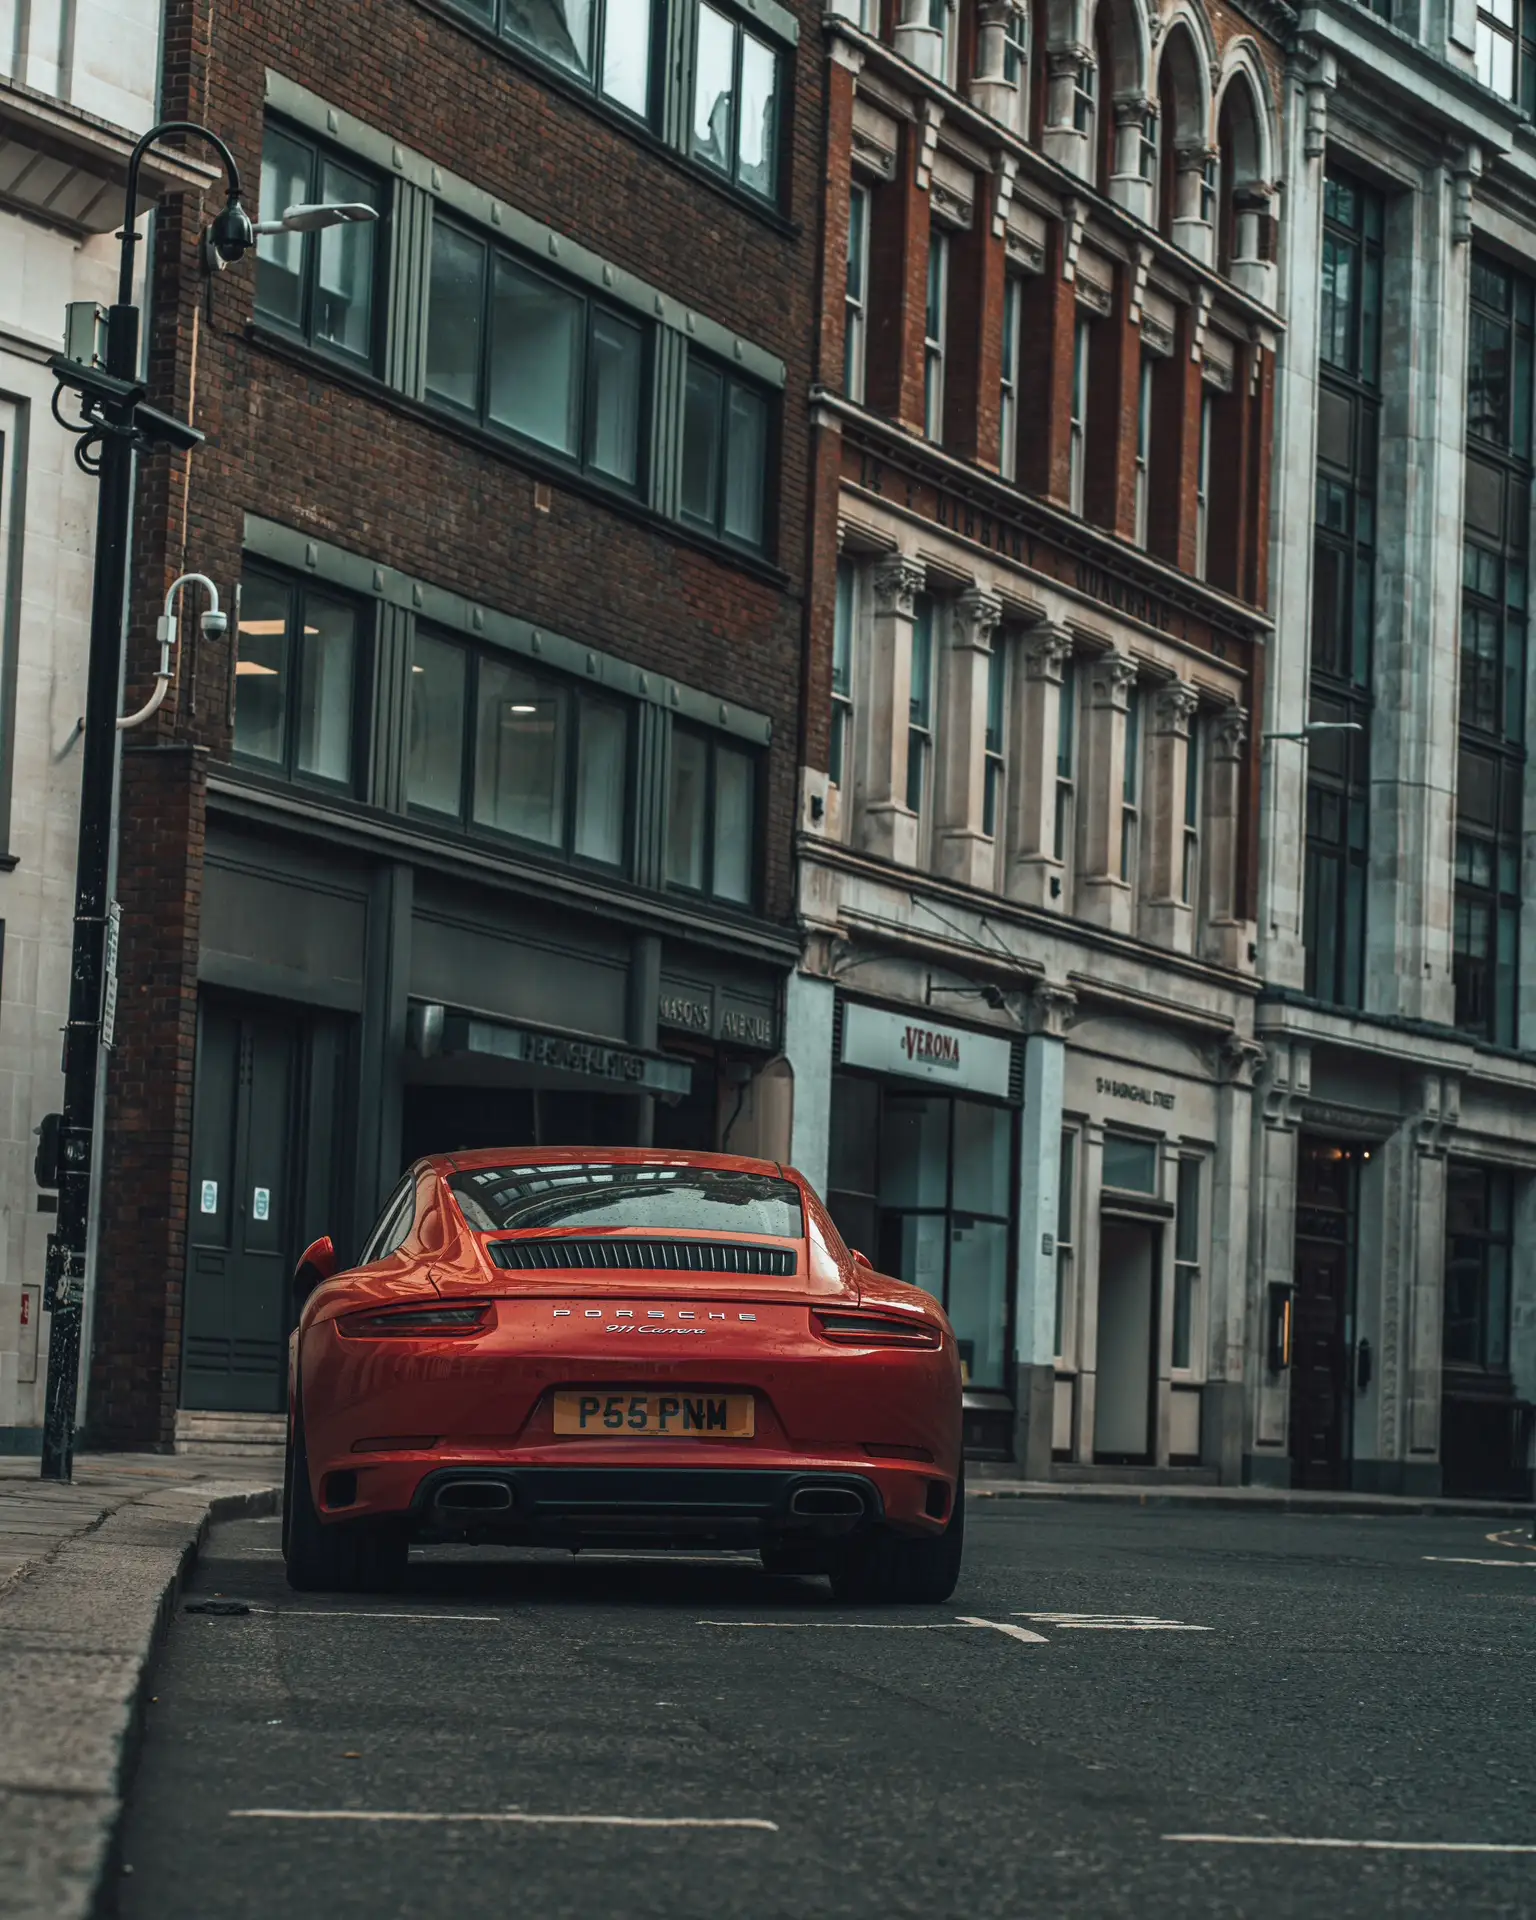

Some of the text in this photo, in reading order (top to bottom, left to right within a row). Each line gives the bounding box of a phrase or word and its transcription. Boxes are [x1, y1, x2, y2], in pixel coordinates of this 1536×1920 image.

[660, 995, 772, 1044] MASONS AVENUE
[905, 1026, 960, 1062] VERONA
[553, 1309, 757, 1321] PORSCHE
[605, 1324, 707, 1334] 911 Carrera
[579, 1397, 728, 1431] P55 PNM
